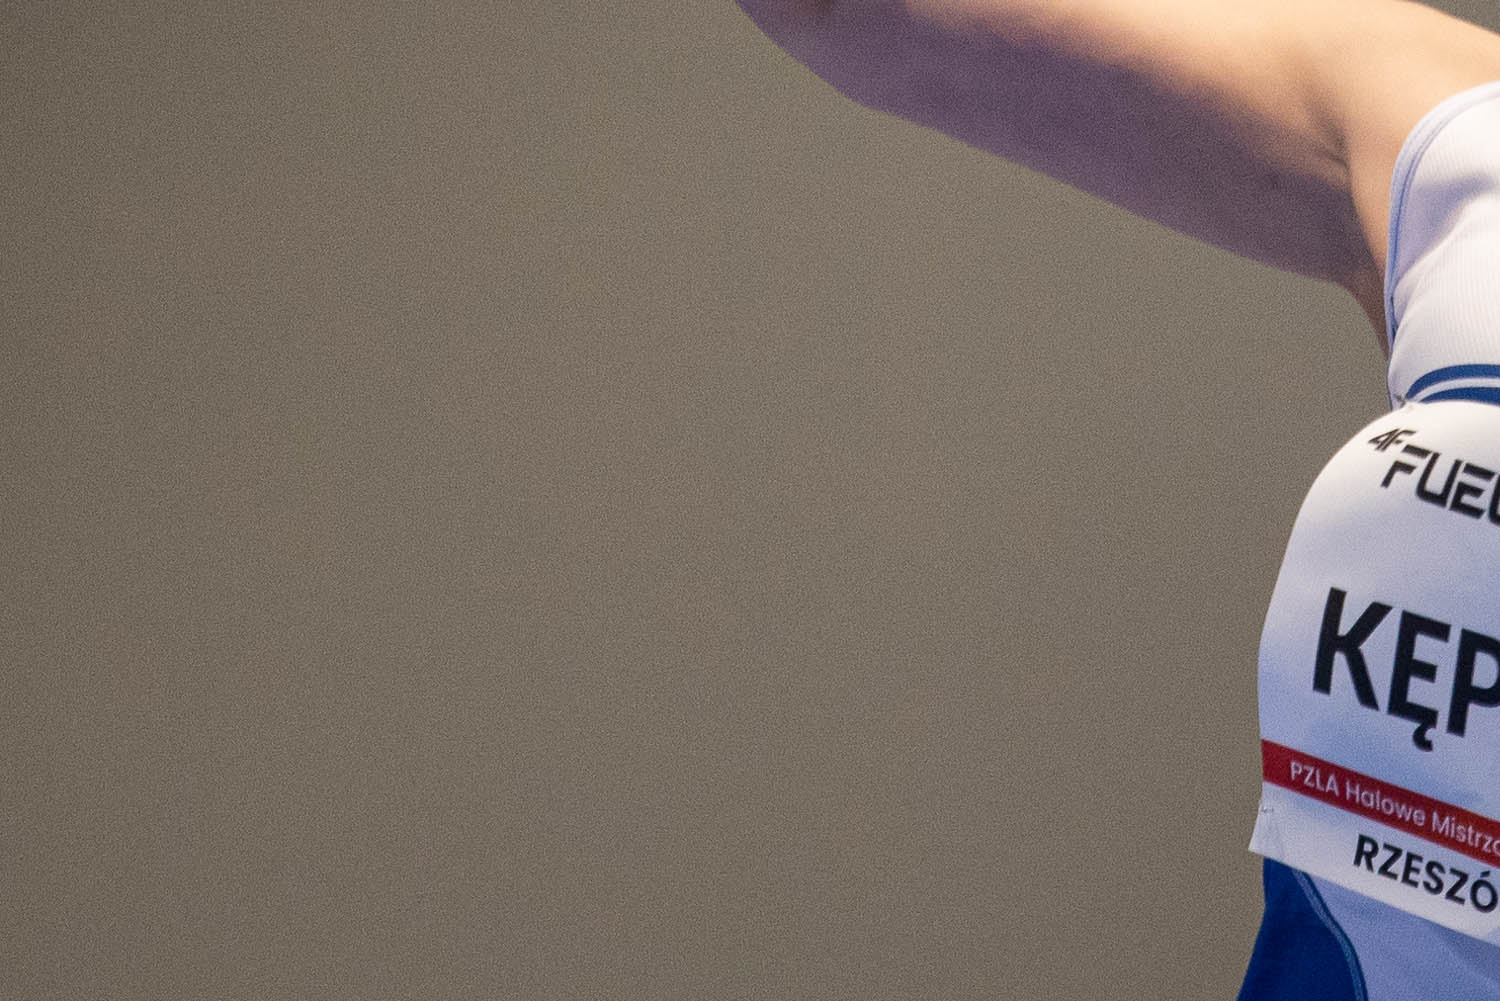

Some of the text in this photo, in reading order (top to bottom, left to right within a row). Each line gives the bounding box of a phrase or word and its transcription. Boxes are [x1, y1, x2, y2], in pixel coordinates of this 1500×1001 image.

[1368, 428, 1416, 452] 4F
[1290, 761, 1340, 796] PZLA
[1345, 781, 1426, 827] Halowe
